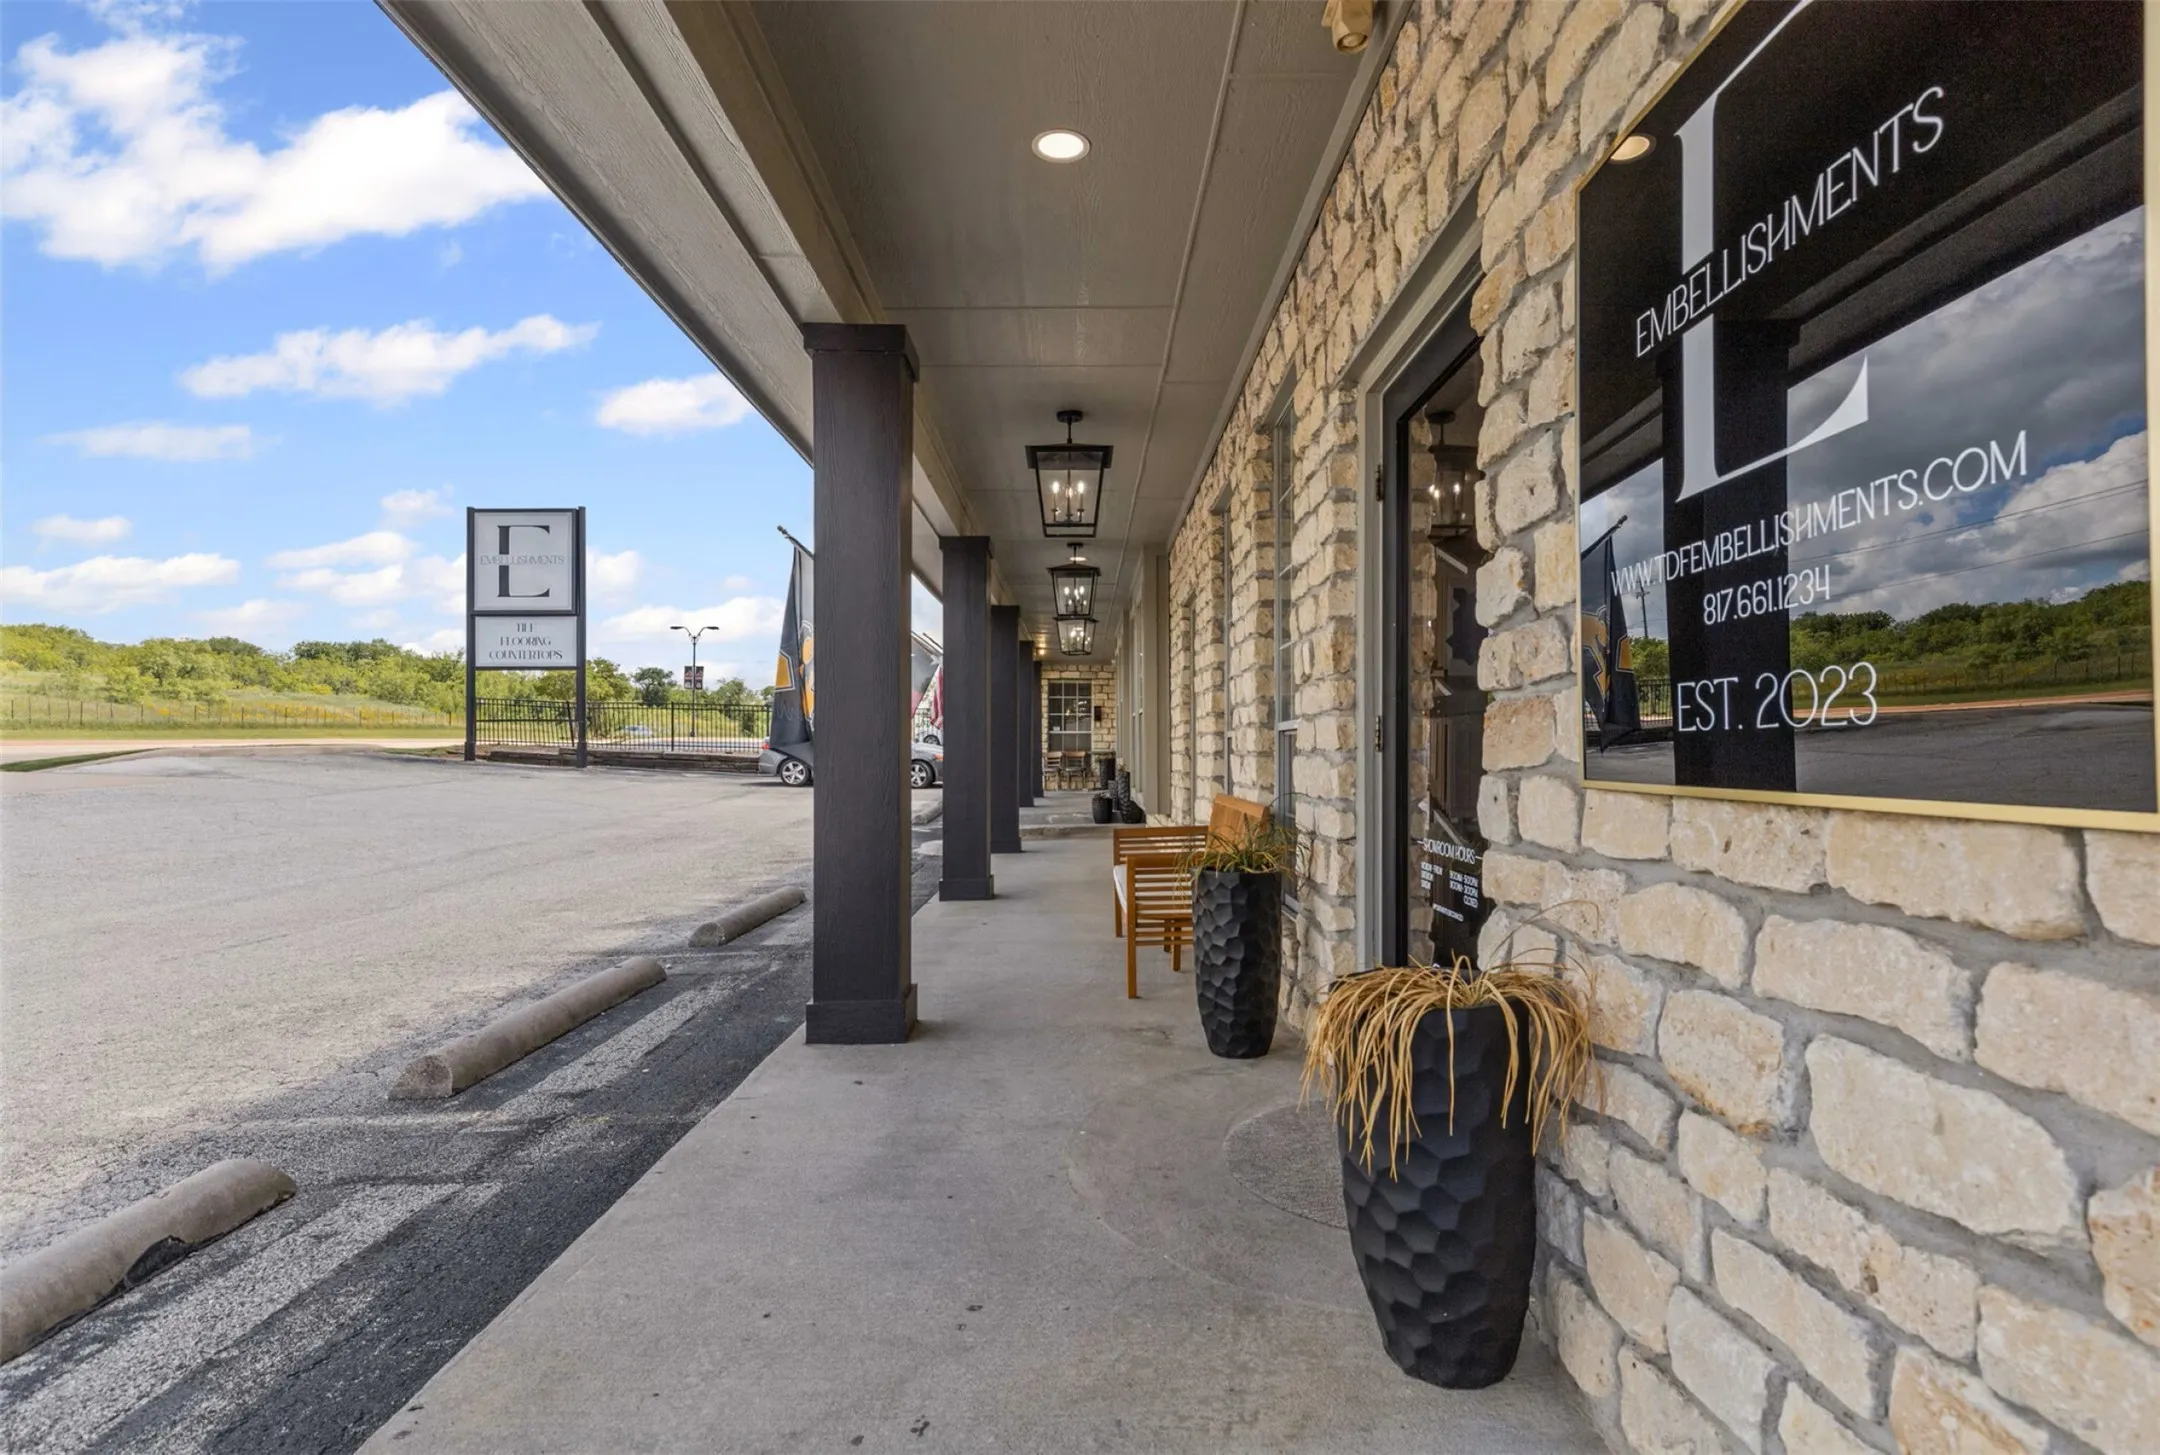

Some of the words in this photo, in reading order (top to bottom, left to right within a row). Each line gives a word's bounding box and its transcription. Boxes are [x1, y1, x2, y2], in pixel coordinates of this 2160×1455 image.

[1635, 86, 1946, 359] EMBELLISHMENTS
[1610, 430, 2029, 597] WWW.TDFEMBELLISHMENTS.COM
[480, 555, 565, 566] EMBELLISHMENTS
[497, 525, 550, 597] E
[1702, 564, 1831, 627] 817.661.1234
[499, 636, 552, 647] FLOORING
[516, 622, 534, 633] TILE
[488, 650, 564, 660] COUNTERTOPS
[1677, 676, 1743, 733] EST.
[1756, 661, 1878, 730] 2023
[1423, 838, 1454, 858] SHOWROOM
[1455, 845, 1475, 864] HOURS
